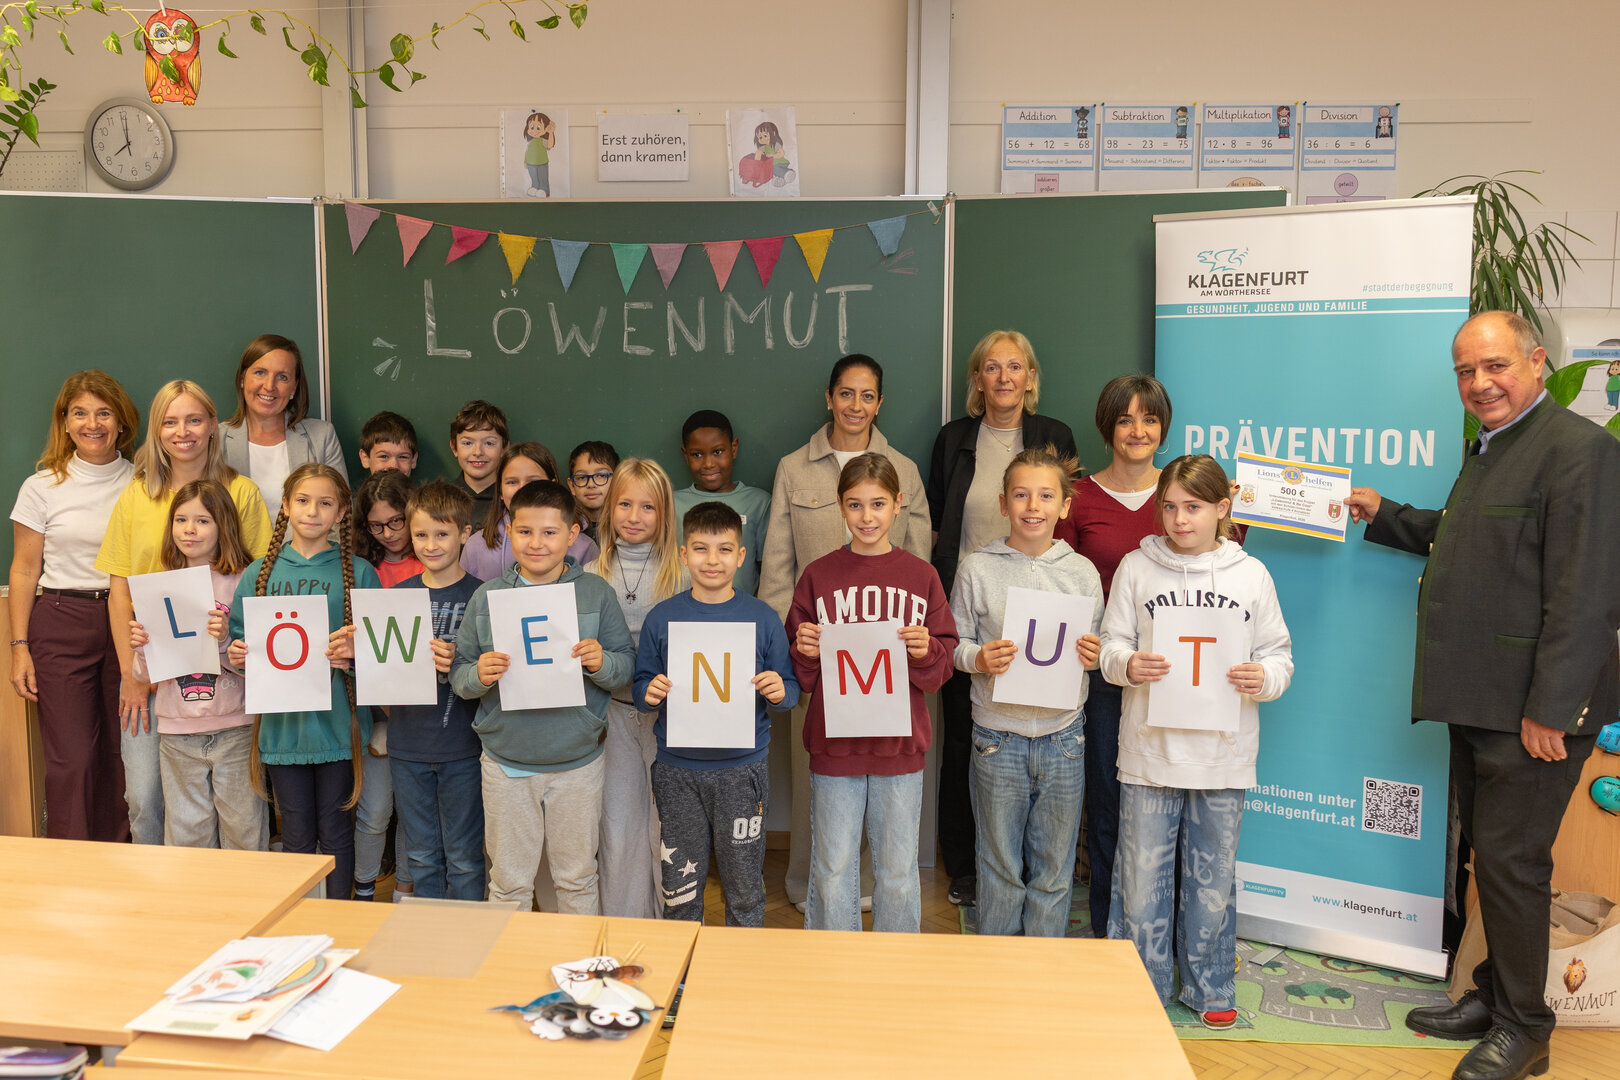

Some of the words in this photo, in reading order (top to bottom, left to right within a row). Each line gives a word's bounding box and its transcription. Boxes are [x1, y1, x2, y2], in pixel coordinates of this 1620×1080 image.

[1019, 110, 1057, 121] Addition
[1112, 110, 1165, 121] Subtraktion
[1207, 109, 1271, 123] Multiplikation
[1321, 109, 1358, 121] Division
[602, 134, 627, 146] Erst
[631, 133, 686, 147] zuhören,
[1008, 139, 1020, 149] 56
[1043, 139, 1055, 149] 12
[1078, 139, 1090, 149] 68
[1106, 139, 1119, 149] 98
[1142, 139, 1154, 149] 23
[1178, 139, 1189, 149] 75
[1207, 139, 1219, 149] 12
[1230, 139, 1237, 149] 8
[1261, 139, 1273, 149] 96
[1307, 139, 1319, 149] 36
[1334, 139, 1341, 149] 6
[1365, 139, 1371, 149] 6
[601, 150, 632, 163] dann
[635, 150, 687, 163] kramen!
[1188, 270, 1309, 289] KLAGENFURT
[1362, 281, 1454, 293] #stadtderbegegnung
[1200, 289, 1213, 297] AM
[1215, 288, 1271, 297] WÖRTHERSEE
[423, 278, 874, 357] LÖWENMUT
[1186, 304, 1251, 315] GESUNDHEIT,
[1254, 303, 1295, 313] JUGEND
[1299, 302, 1320, 312] UND
[1324, 301, 1367, 311] FAMILIE
[1185, 419, 1435, 467] PRÄVENTION
[1257, 469, 1281, 479] Lions
[1305, 474, 1333, 487] helfen
[1280, 486, 1297, 496] 500
[1299, 490, 1305, 498] €
[271, 579, 331, 597] HAPPY
[816, 585, 928, 628] AMOUR
[1144, 589, 1251, 622] HOLLIST
[164, 597, 197, 639] L
[266, 611, 309, 671] Ö
[362, 616, 422, 664] W
[521, 615, 553, 665] E
[1025, 618, 1067, 667] U
[1178, 636, 1217, 687] T
[692, 652, 731, 703] N
[836, 648, 894, 696] M
[1245, 784, 1313, 802] mationen
[1318, 792, 1356, 809] unter
[733, 816, 762, 840] 08
[1312, 894, 1418, 922] www.klagenfurt.at
[1545, 990, 1617, 1011] WENMUT
